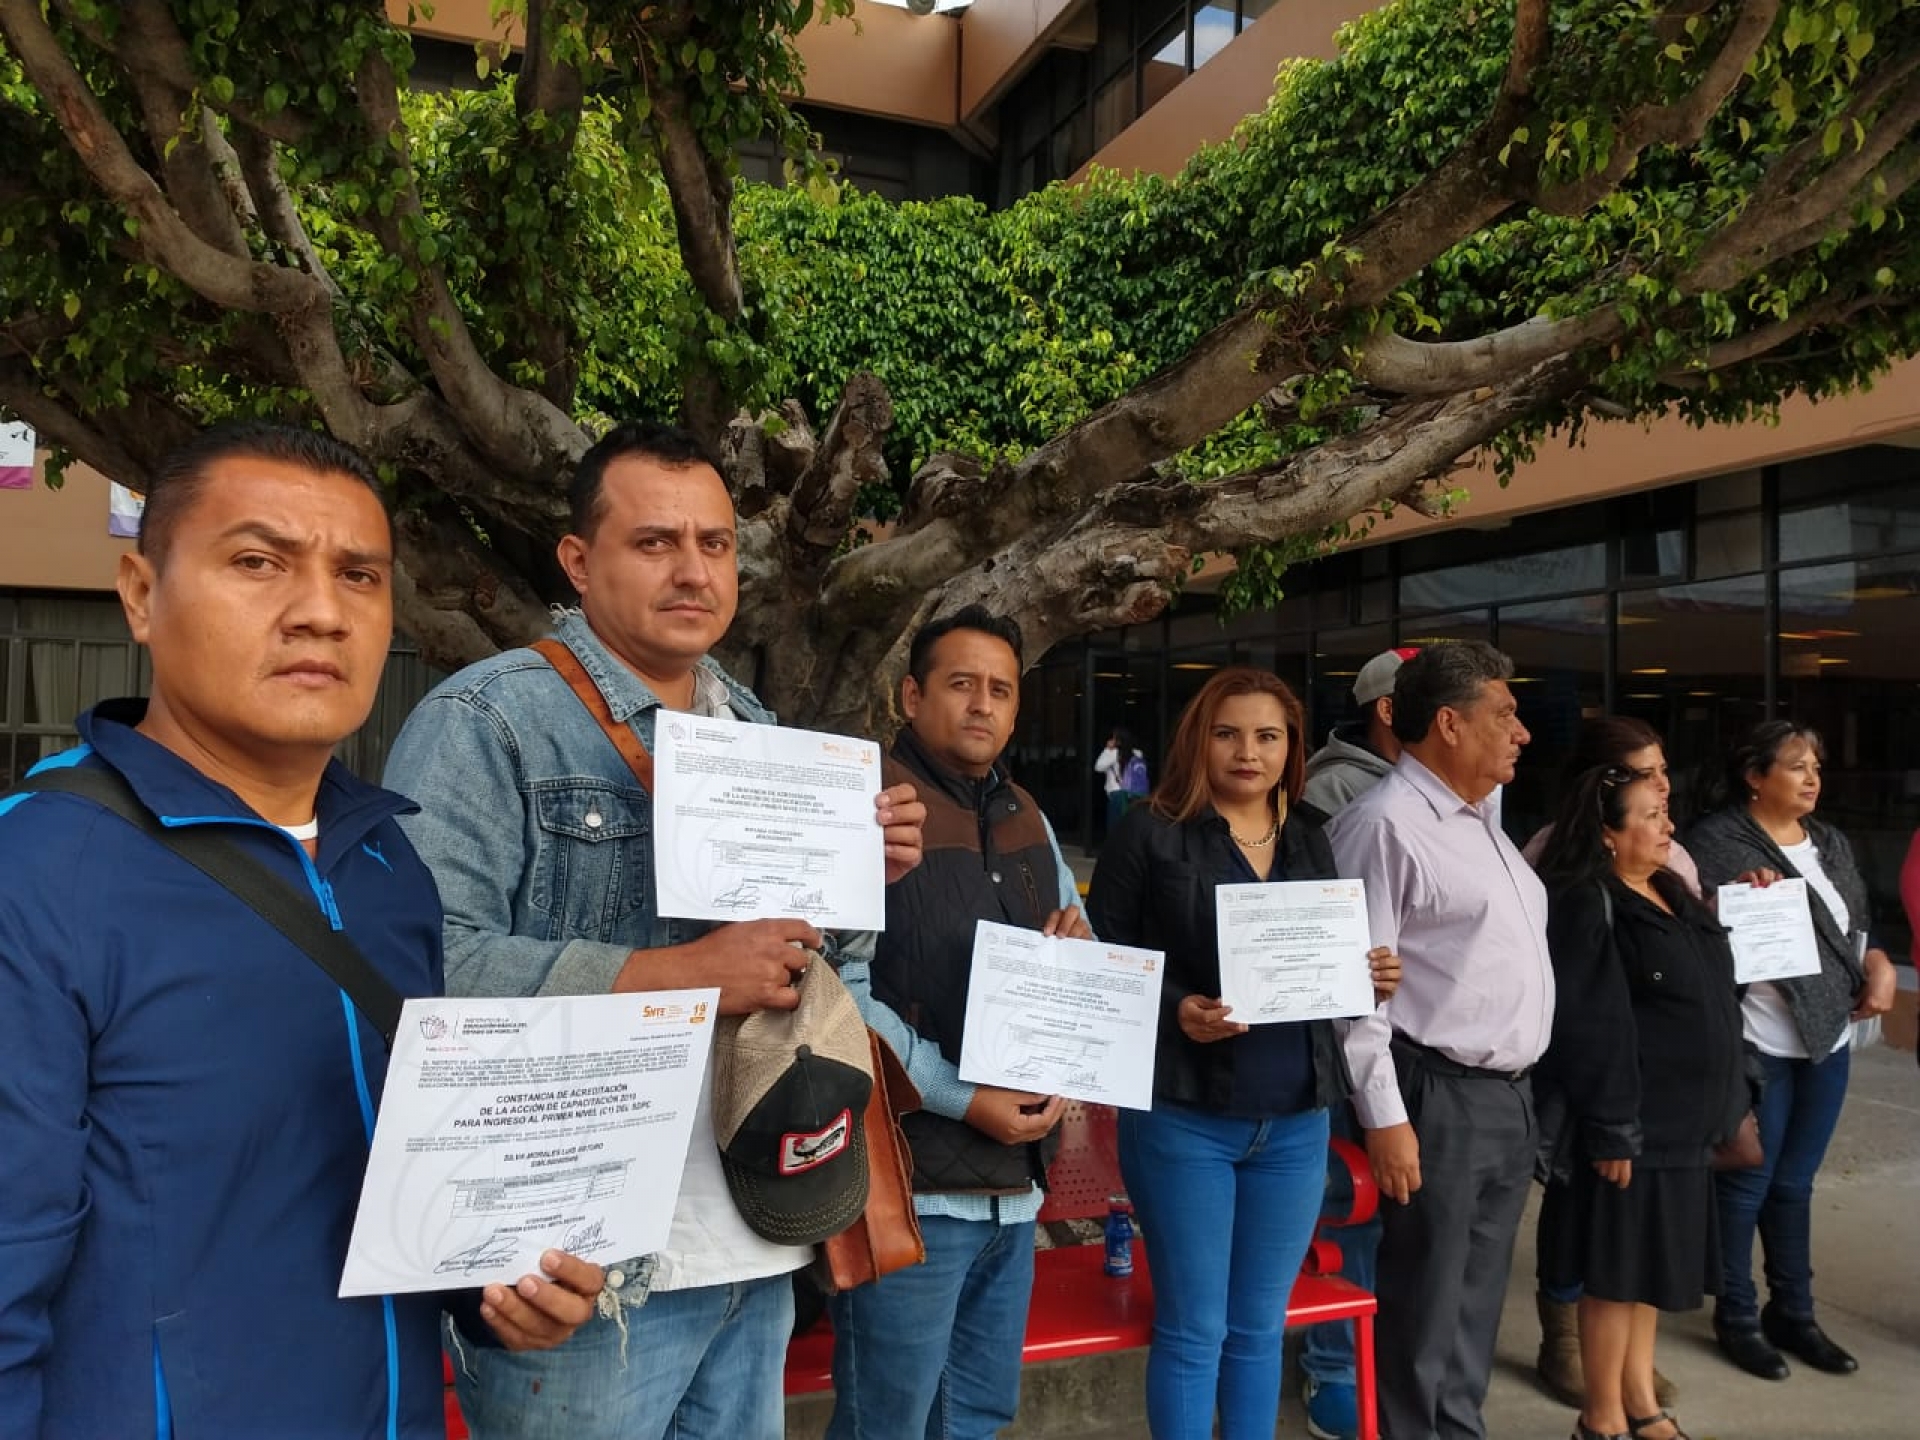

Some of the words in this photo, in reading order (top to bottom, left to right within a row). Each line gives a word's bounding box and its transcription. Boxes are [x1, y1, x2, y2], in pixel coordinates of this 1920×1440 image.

[496, 1091, 555, 1104] CONSTANCIA
[557, 1090, 568, 1099] DE
[571, 1083, 628, 1097] ACREDITACIÓN
[453, 1118, 481, 1128] PARA
[483, 1116, 526, 1127] INGRESO
[528, 1115, 539, 1124] AL
[541, 1111, 574, 1123] PRIMER
[575, 1109, 597, 1118] NIVEL
[615, 1104, 629, 1114] DEL
[479, 1106, 493, 1116] DE
[495, 1105, 508, 1115] LA
[510, 1103, 545, 1114] ACCIÓN
[546, 1102, 558, 1111] DE
[560, 1094, 619, 1109] CAPACITACIÓN
